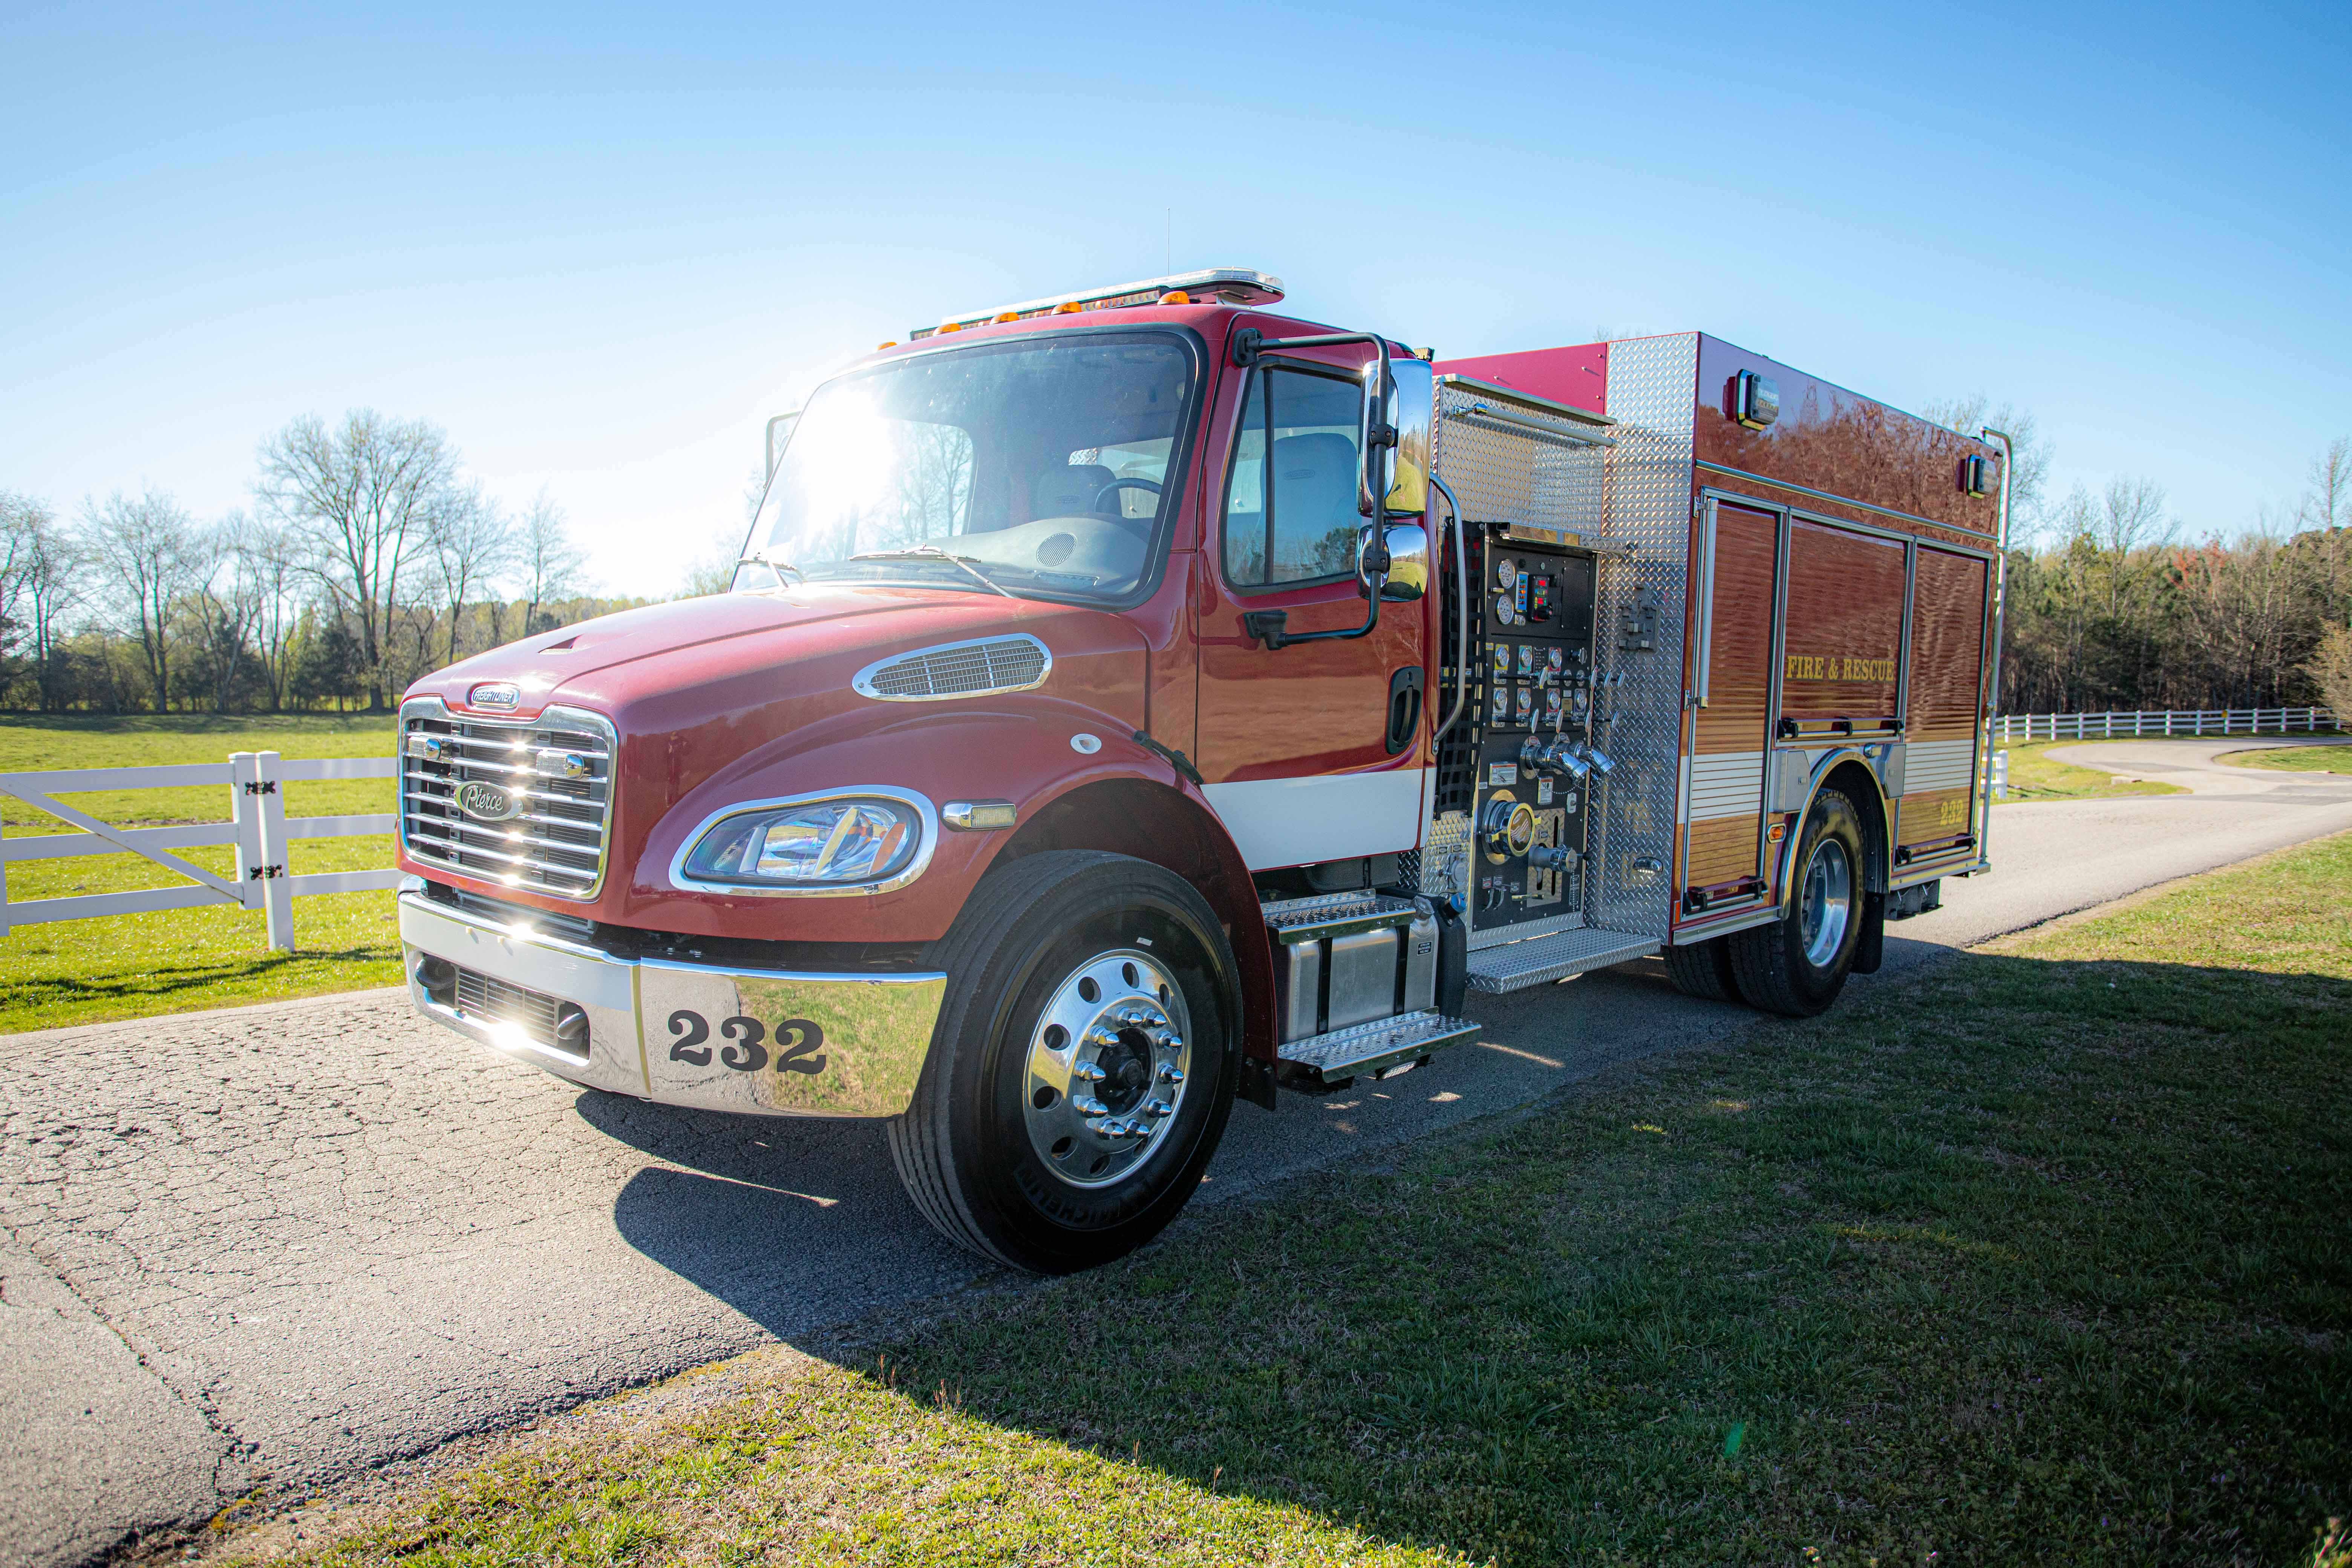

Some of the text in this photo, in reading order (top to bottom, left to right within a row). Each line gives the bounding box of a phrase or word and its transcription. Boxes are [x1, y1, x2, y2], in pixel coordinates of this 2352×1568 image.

[1786, 655, 1894, 682] FIRE & RESCUE
[474, 691, 513, 703] FREIGHTLINER
[466, 784, 504, 811] Pierce
[1940, 799, 1963, 826] 232
[668, 1009, 827, 1075] 232
